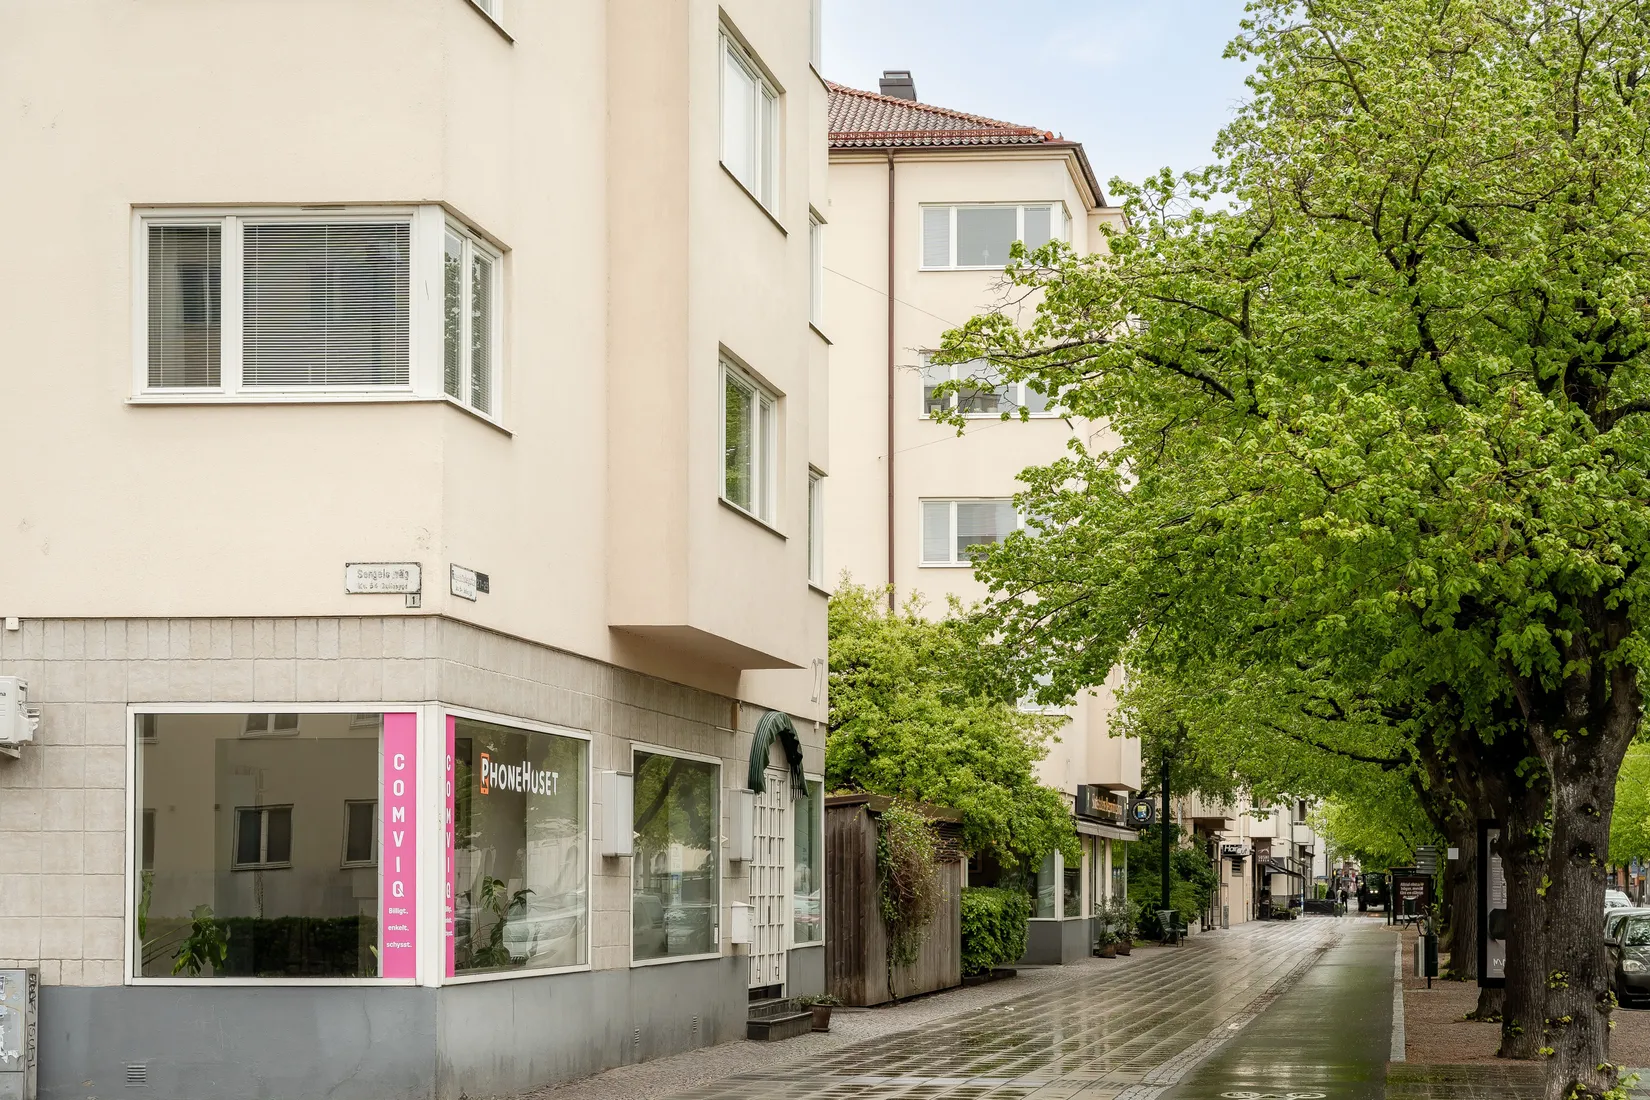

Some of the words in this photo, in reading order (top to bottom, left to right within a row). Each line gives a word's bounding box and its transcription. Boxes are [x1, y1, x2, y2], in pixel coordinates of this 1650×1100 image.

[357, 569, 390, 580] Sergels
[411, 596, 415, 604] 1
[810, 658, 824, 704] 27
[392, 753, 405, 897] COMVIQ
